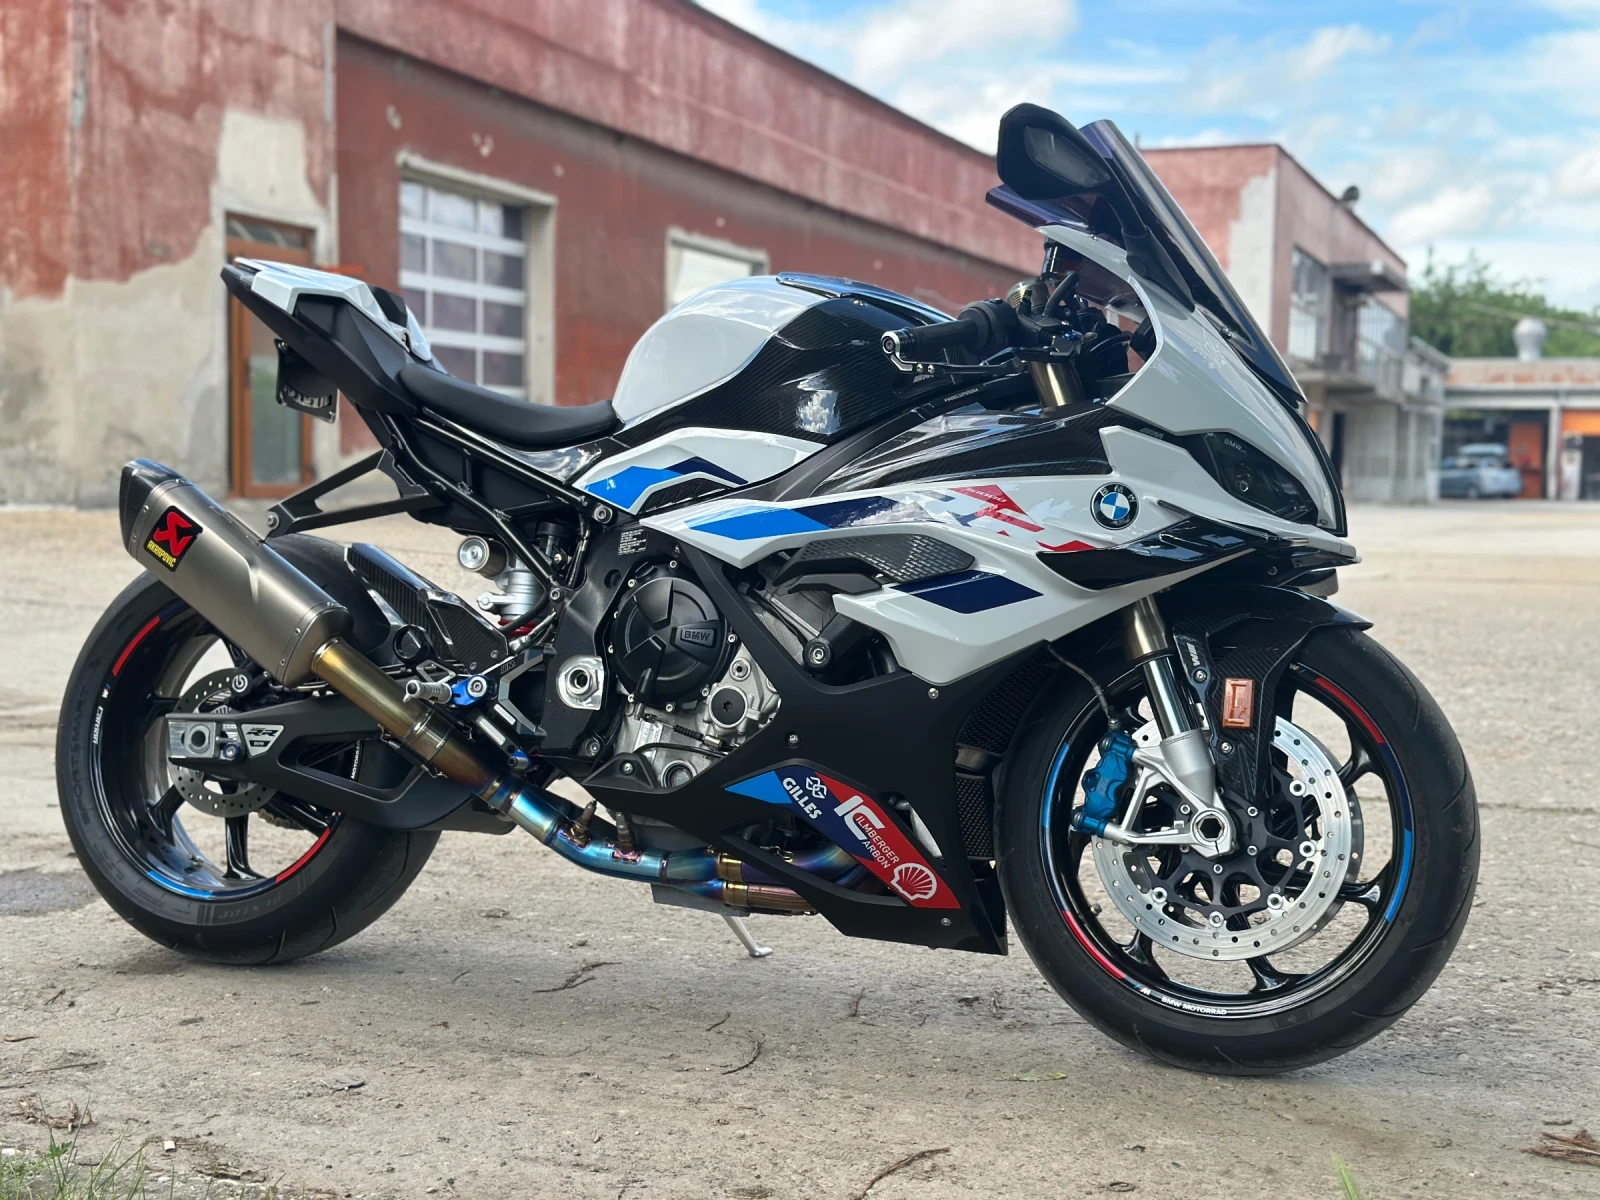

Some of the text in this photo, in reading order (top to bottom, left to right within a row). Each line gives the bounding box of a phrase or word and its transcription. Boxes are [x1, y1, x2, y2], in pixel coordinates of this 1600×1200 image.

[1223, 438, 1242, 451] BMW
[684, 630, 711, 641] BMW
[782, 777, 822, 819] GILLES
[855, 815, 900, 864] ILMBERGER
[1161, 996, 1182, 1008] BMW
[1183, 1003, 1227, 1015] MOTORRAD
